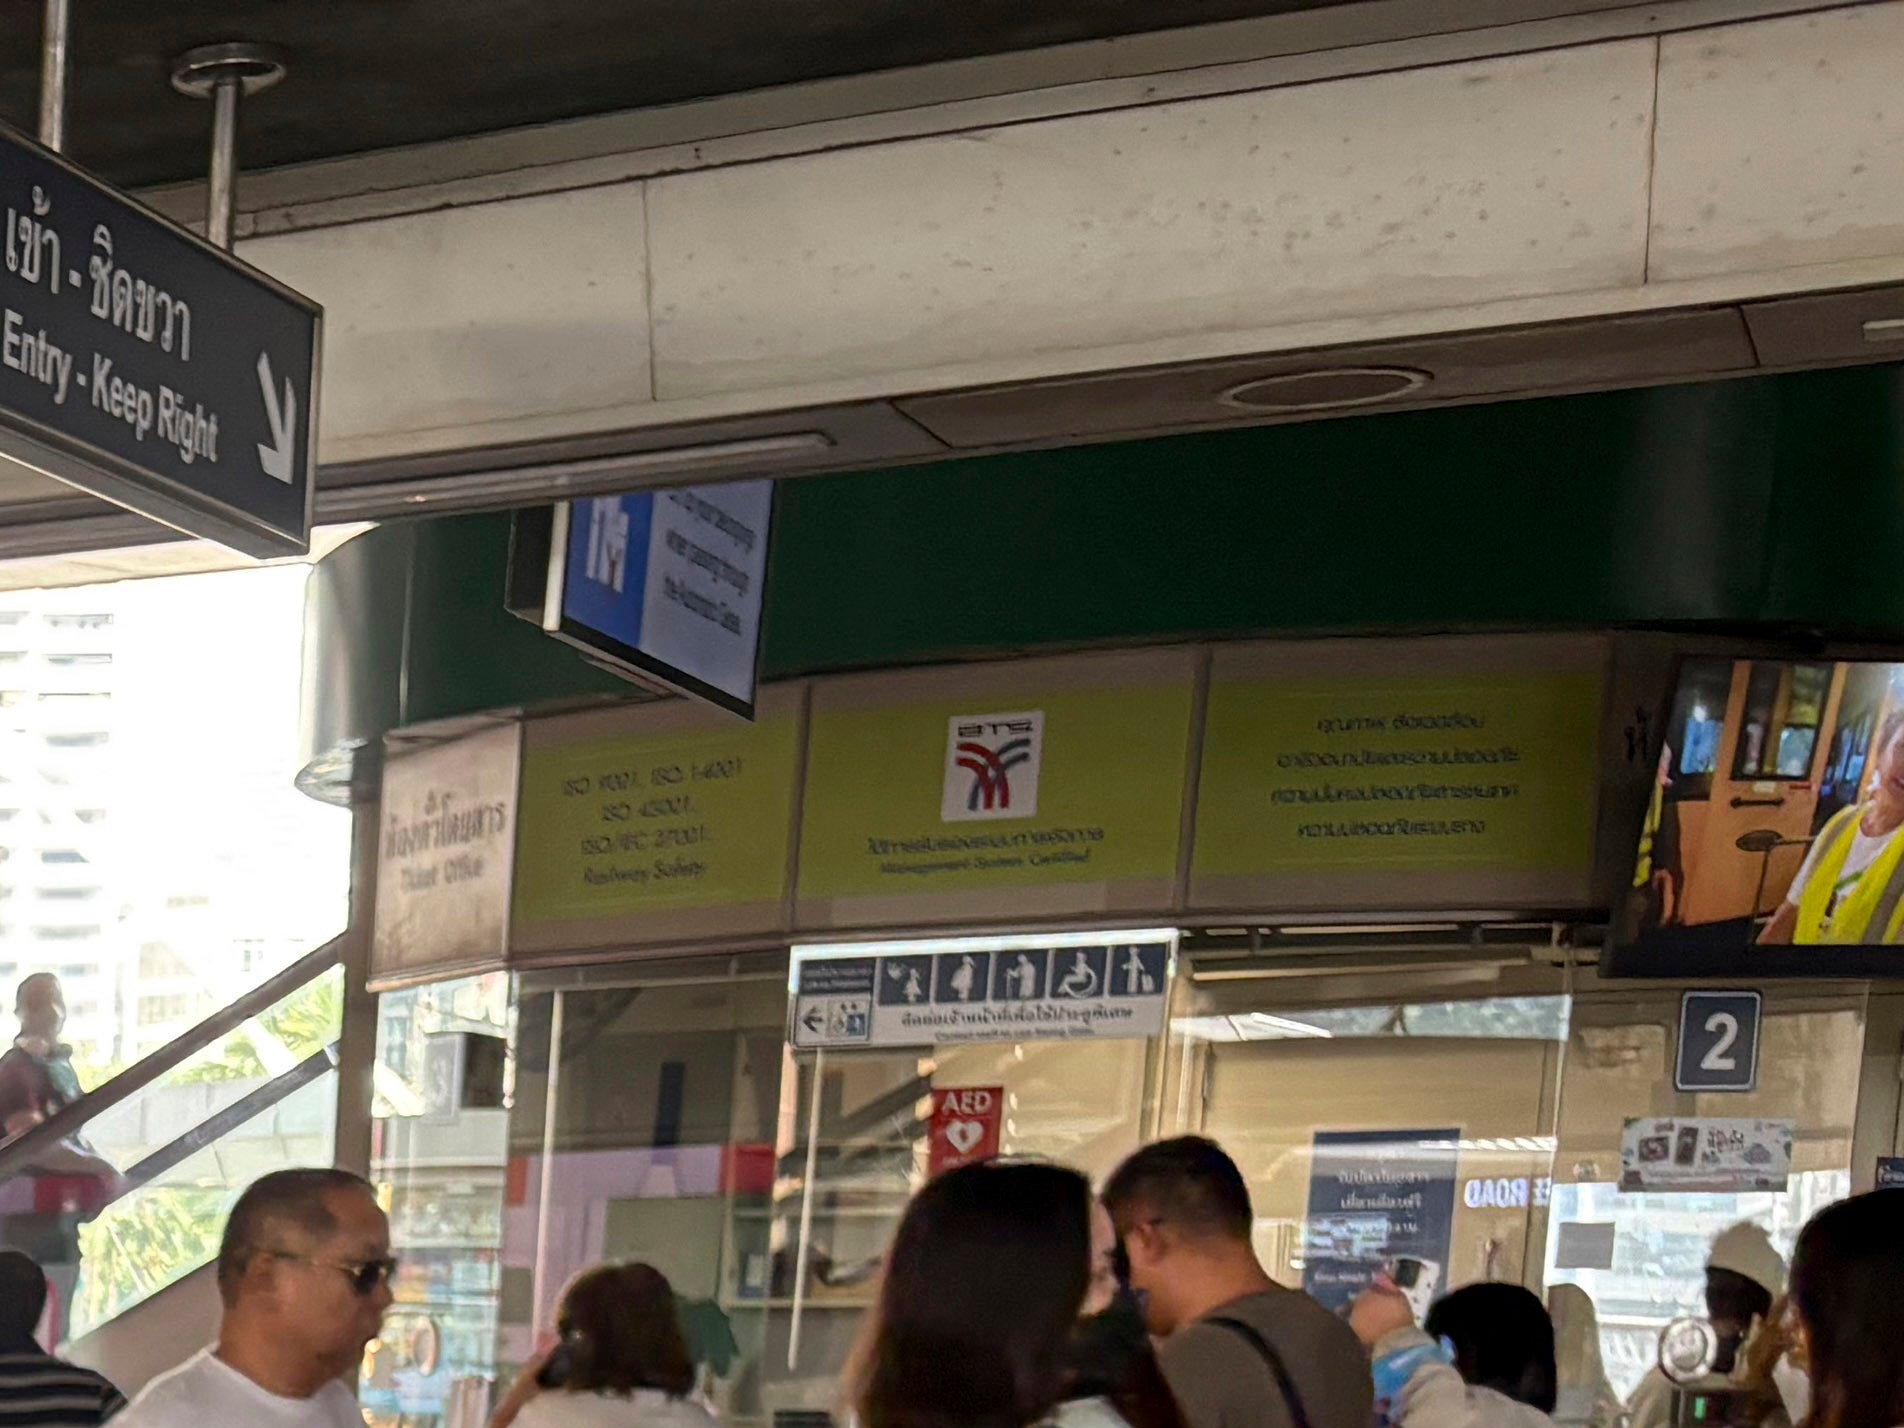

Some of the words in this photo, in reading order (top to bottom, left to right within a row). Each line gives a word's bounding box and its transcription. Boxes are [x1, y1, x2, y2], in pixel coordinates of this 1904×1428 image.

[5, 185, 61, 294] เข้า
[89, 224, 191, 361] ชิดขวา
[3, 308, 72, 405] Entry
[92, 352, 154, 441] Keep
[158, 384, 219, 464] Right
[1699, 1011, 1739, 1071] 2
[943, 1090, 992, 1115] AED
